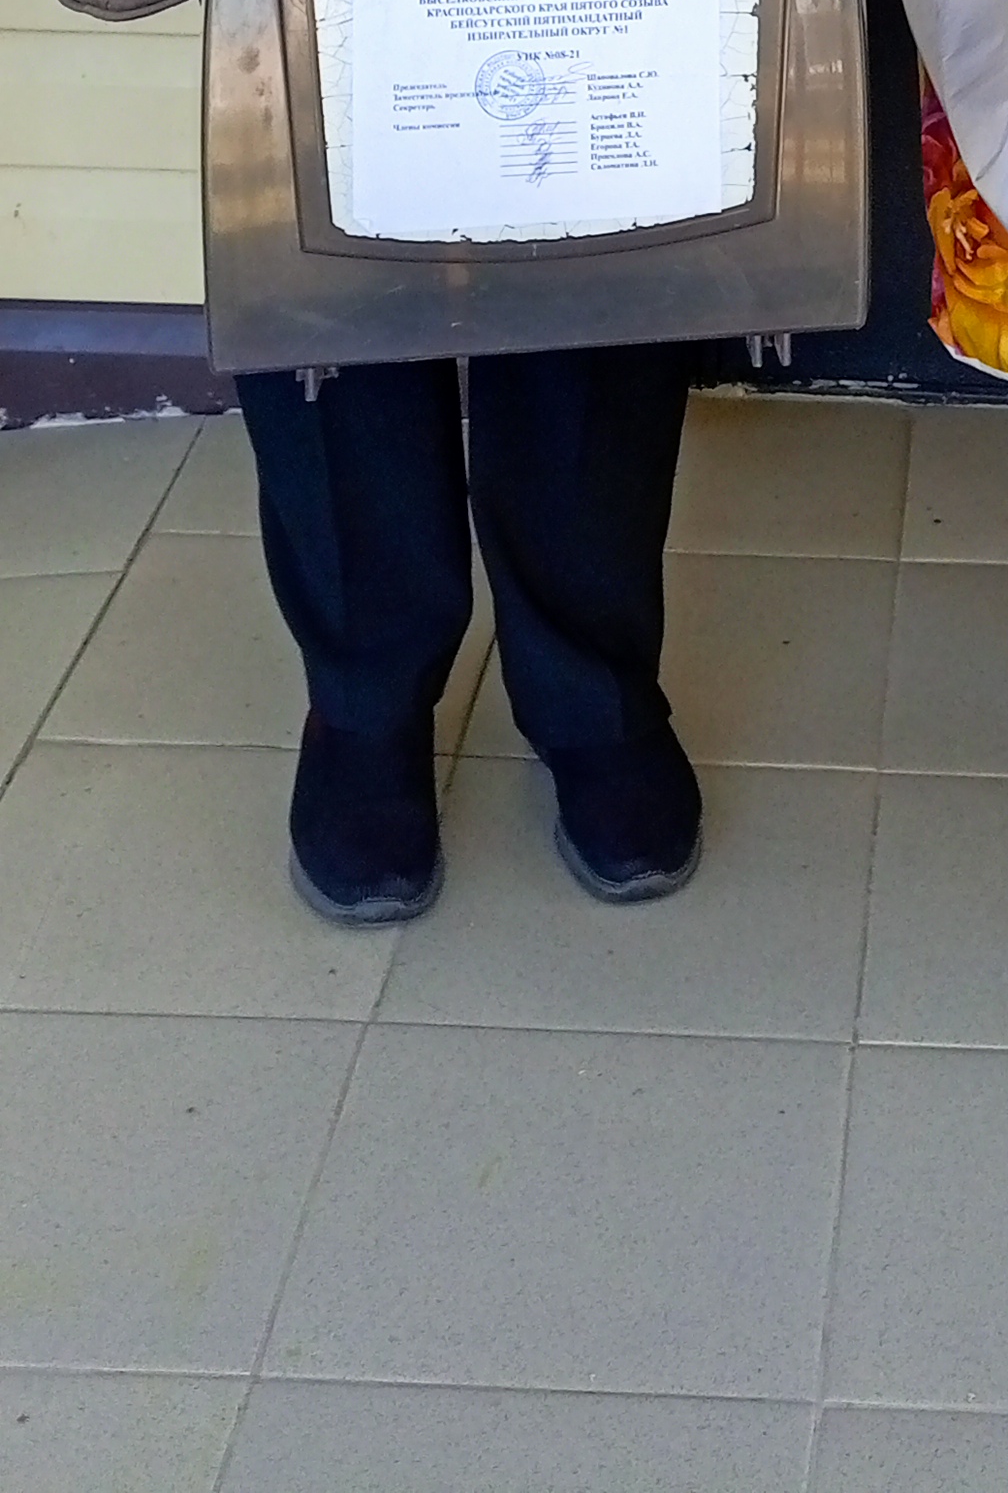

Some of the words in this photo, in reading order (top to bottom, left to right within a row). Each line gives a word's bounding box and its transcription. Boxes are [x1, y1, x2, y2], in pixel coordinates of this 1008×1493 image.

[427, 4, 536, 18] КРАСНОДАРСКОГО
[539, 2, 567, 12] КРАЯ
[571, 0, 618, 11] ПЯТОГО
[467, 27, 568, 41] ИЗБИРАТЕЛЬНЫЙ
[571, 26, 607, 35] ОКРУГ
